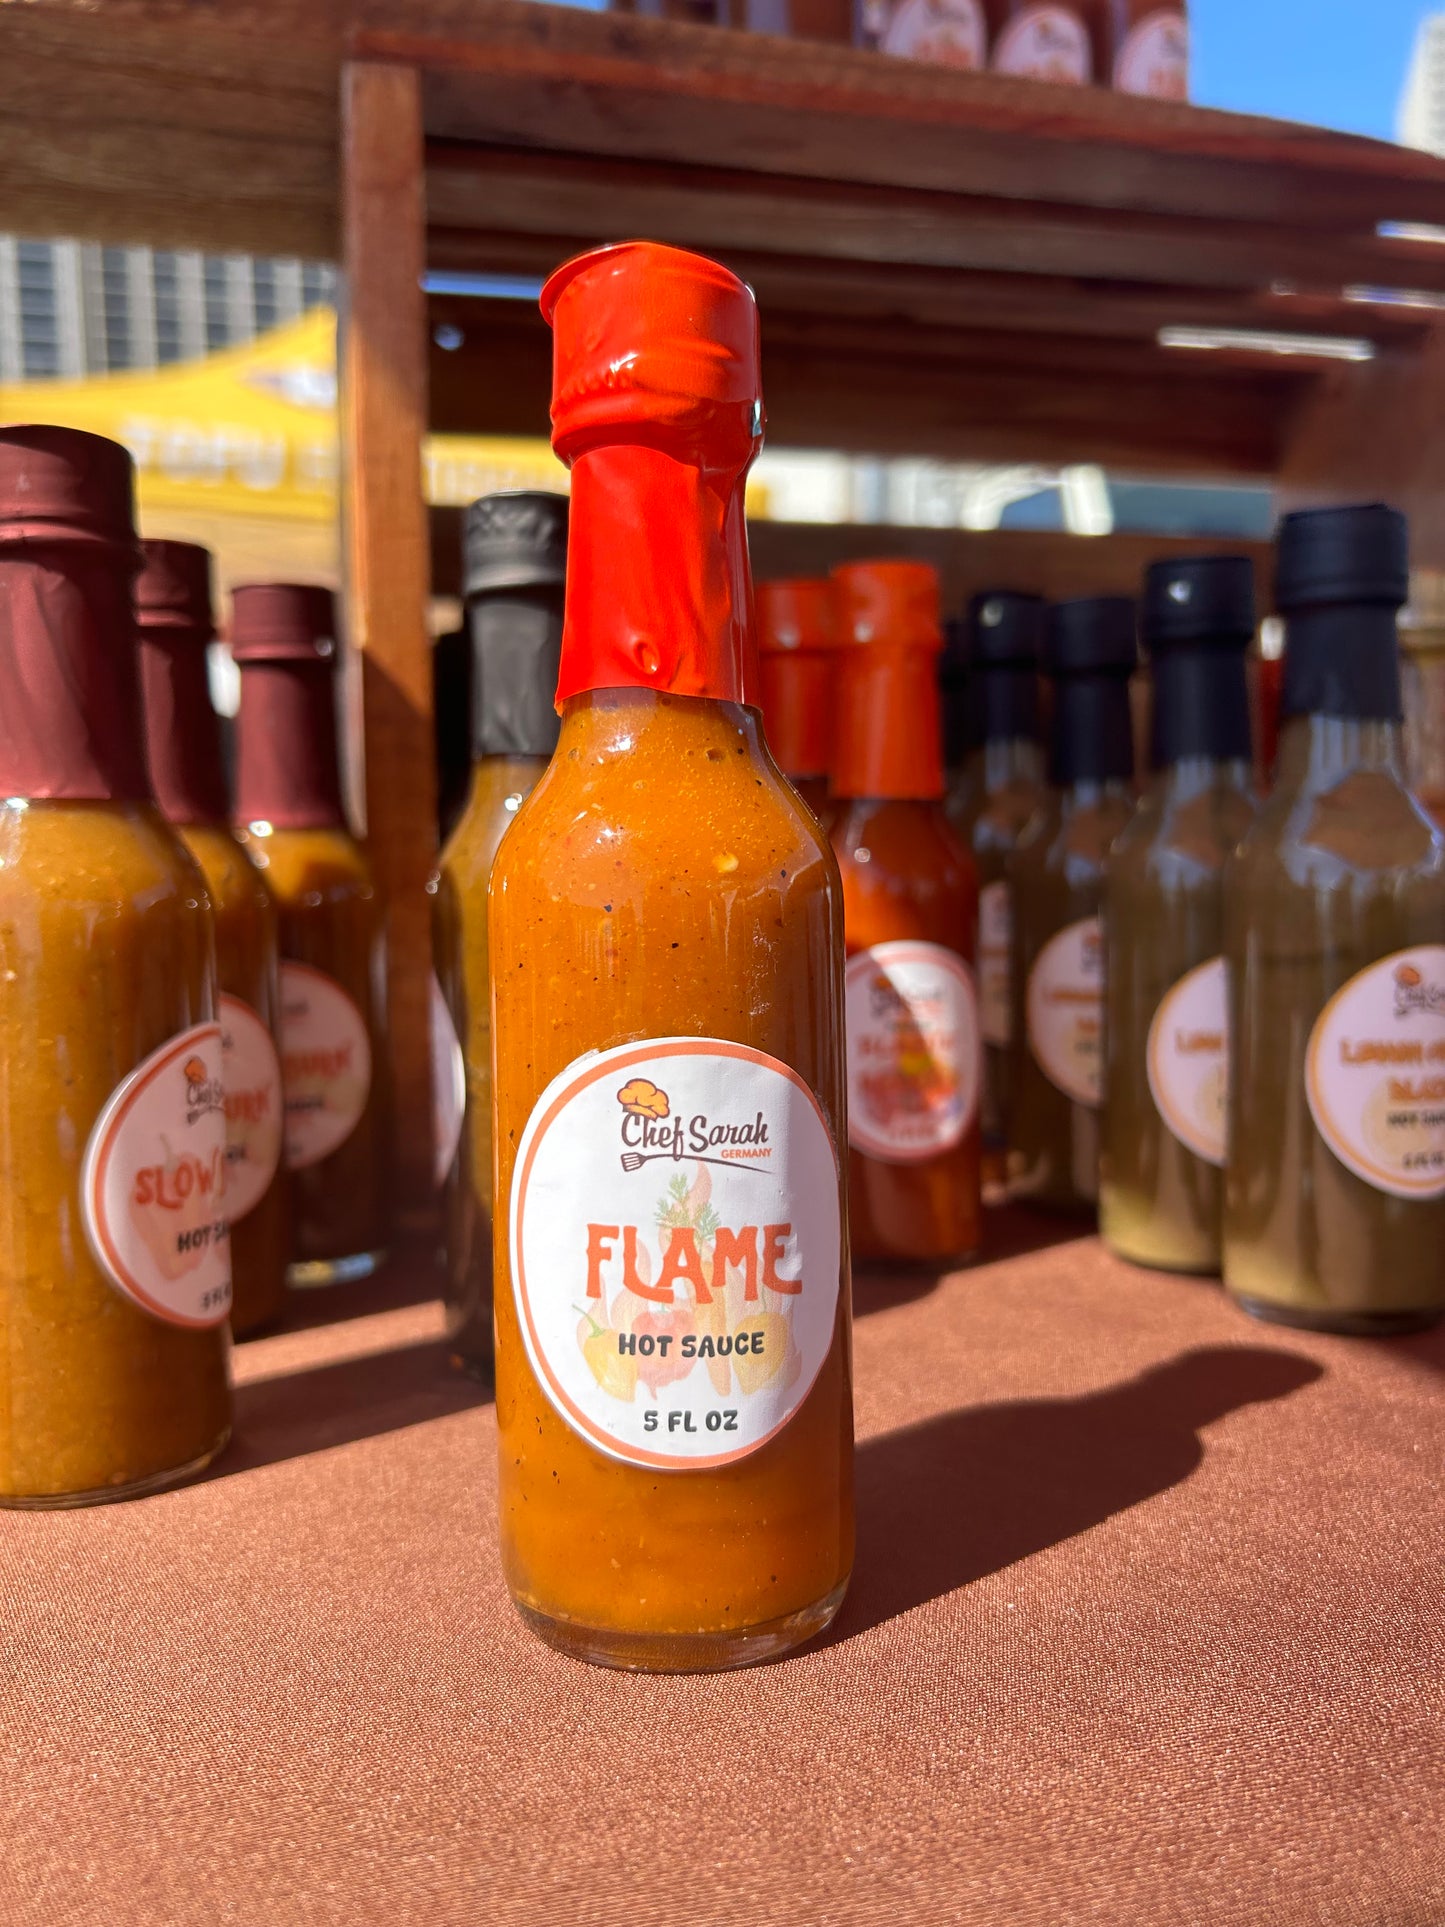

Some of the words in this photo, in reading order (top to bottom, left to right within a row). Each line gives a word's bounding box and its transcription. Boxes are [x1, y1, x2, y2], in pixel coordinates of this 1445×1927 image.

[621, 1113, 683, 1161] Chef
[689, 1112, 768, 1152] Sarah
[721, 1148, 772, 1159] GERMANY
[586, 1223, 802, 1304] FLAME
[618, 1333, 672, 1357] HOT
[681, 1331, 765, 1357] SAUCE
[644, 1410, 658, 1431] 5
[668, 1410, 697, 1432] FL
[705, 1409, 738, 1431] OZ
